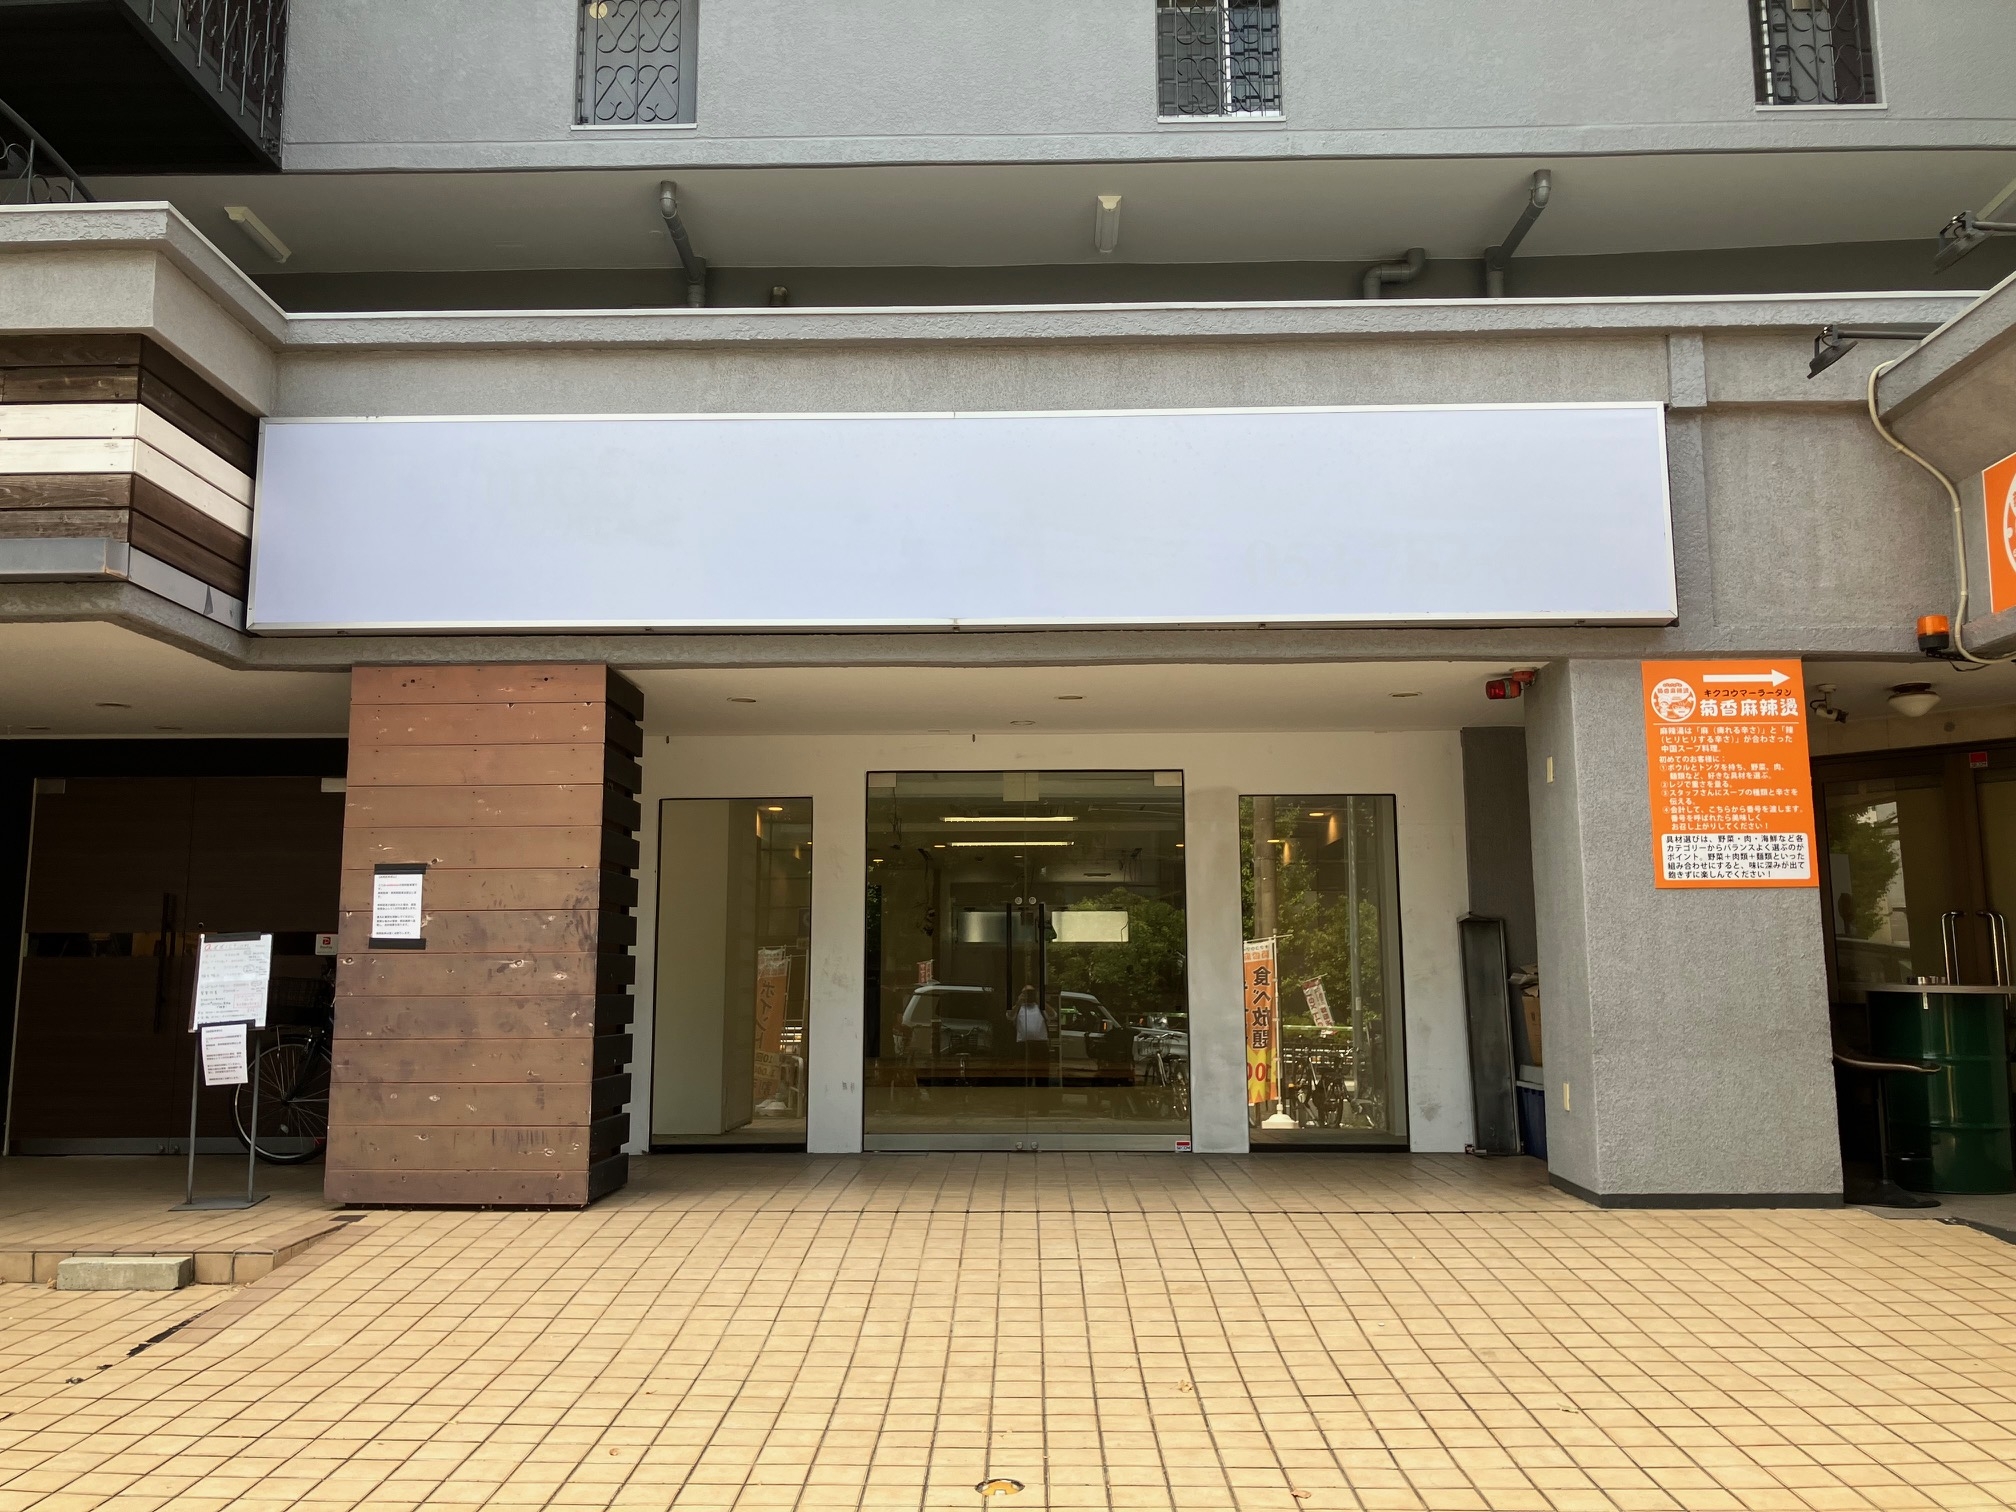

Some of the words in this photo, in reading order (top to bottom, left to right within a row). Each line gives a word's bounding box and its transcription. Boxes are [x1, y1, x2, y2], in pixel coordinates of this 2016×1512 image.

[1704, 688, 1792, 698] キクコウマーラータン
[1666, 835, 1803, 844] 具材選びは、野菜・肉・海鮮など各
[1666, 844, 1804, 852] カテゴリーからバランスよく選ぶのが
[1667, 861, 1805, 870] 組み合わせにすると、味に深みが出て
